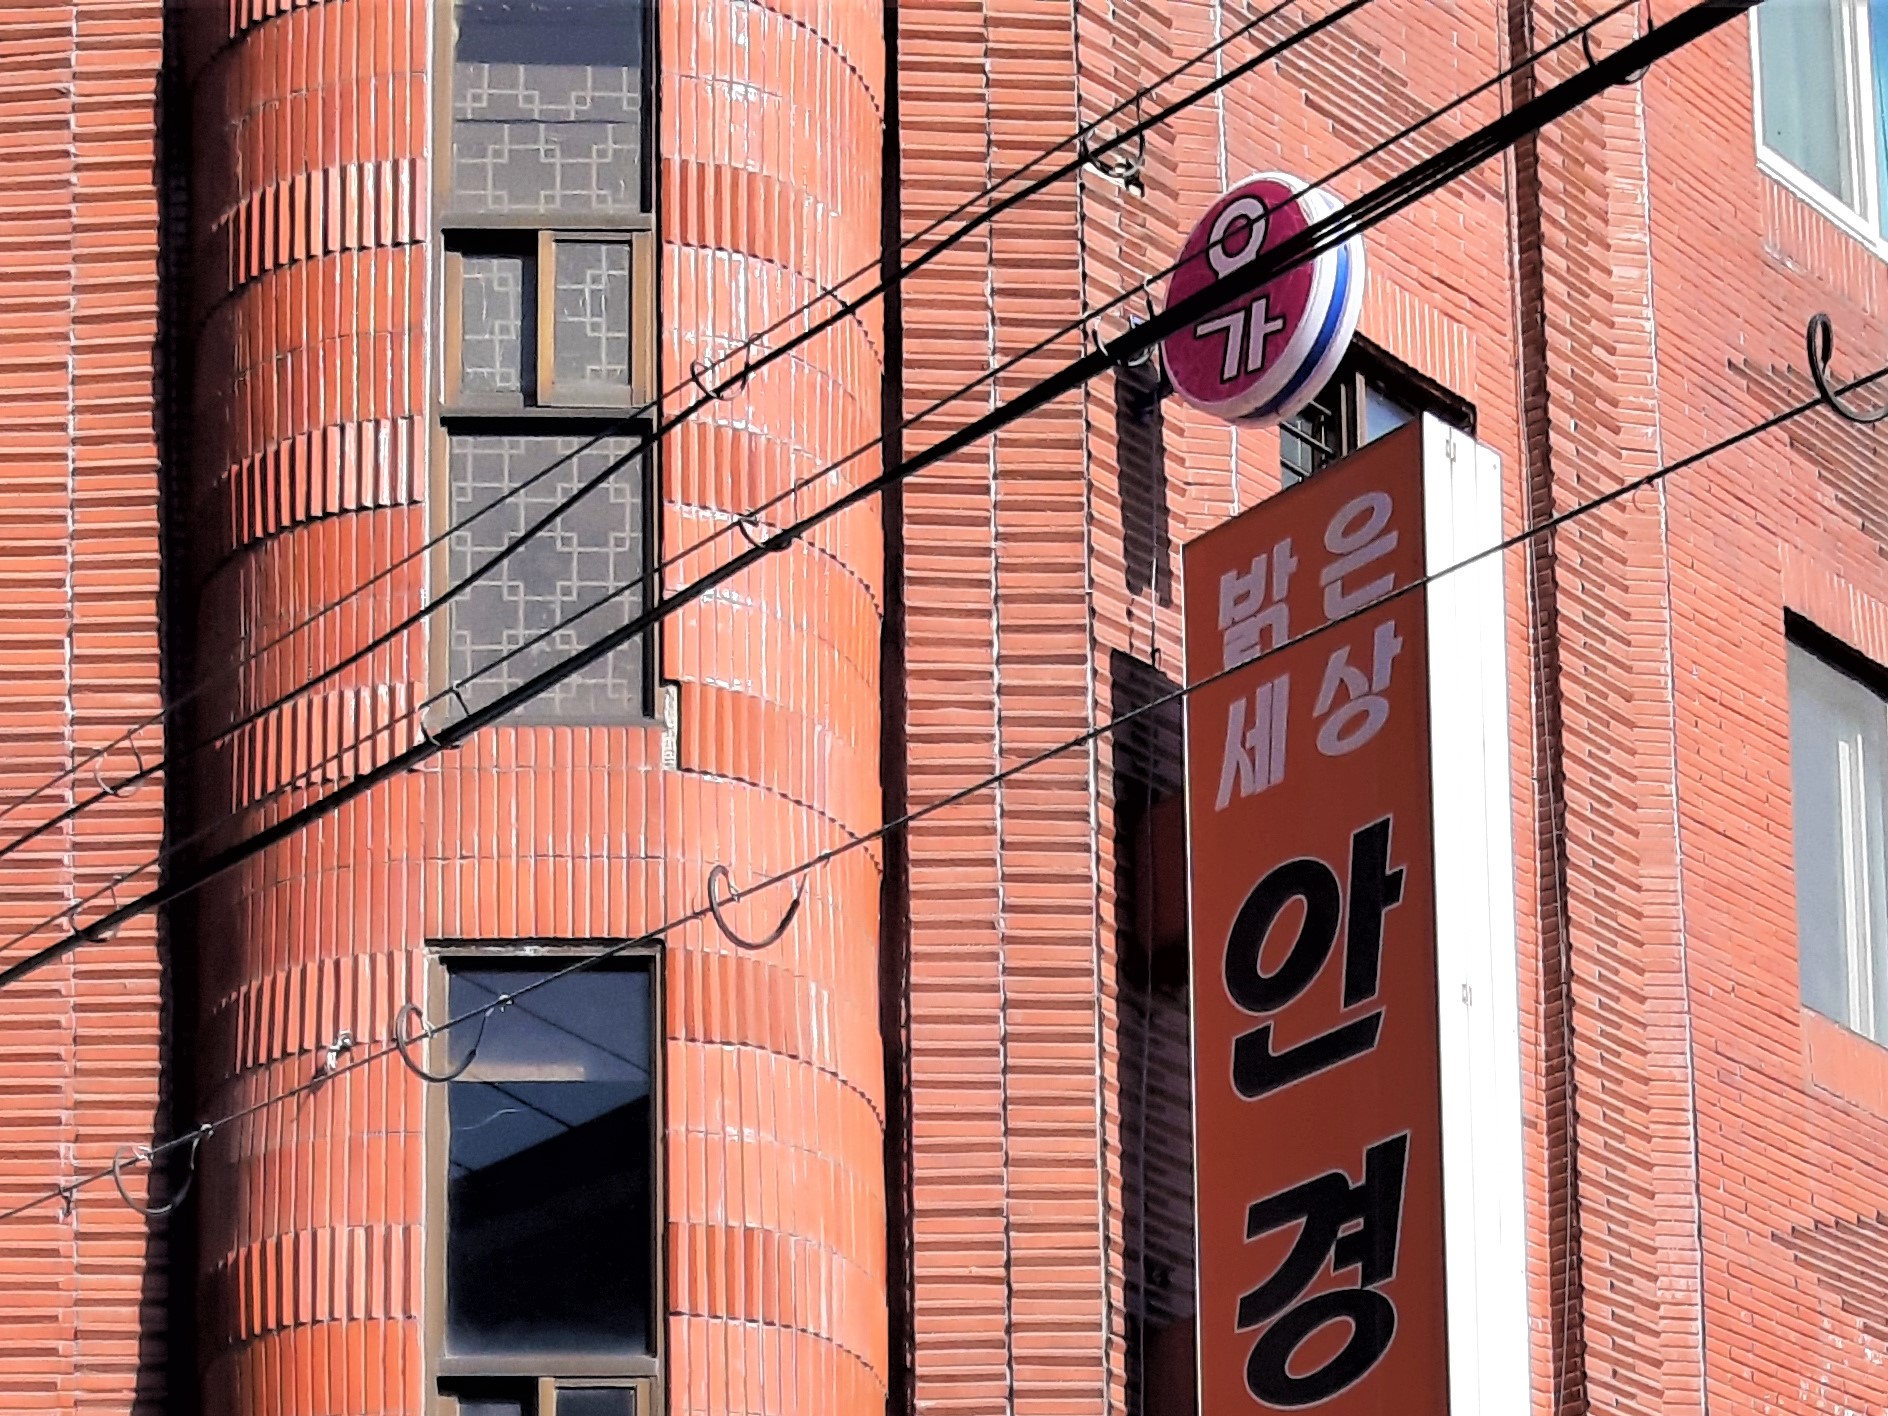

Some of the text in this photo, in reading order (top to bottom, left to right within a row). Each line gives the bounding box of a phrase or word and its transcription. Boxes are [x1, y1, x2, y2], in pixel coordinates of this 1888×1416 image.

[1194, 195, 1287, 383] 요가
[1217, 490, 1400, 670] 밝은
[1215, 618, 1404, 812] 세상
[1224, 815, 1407, 1411] 안경
